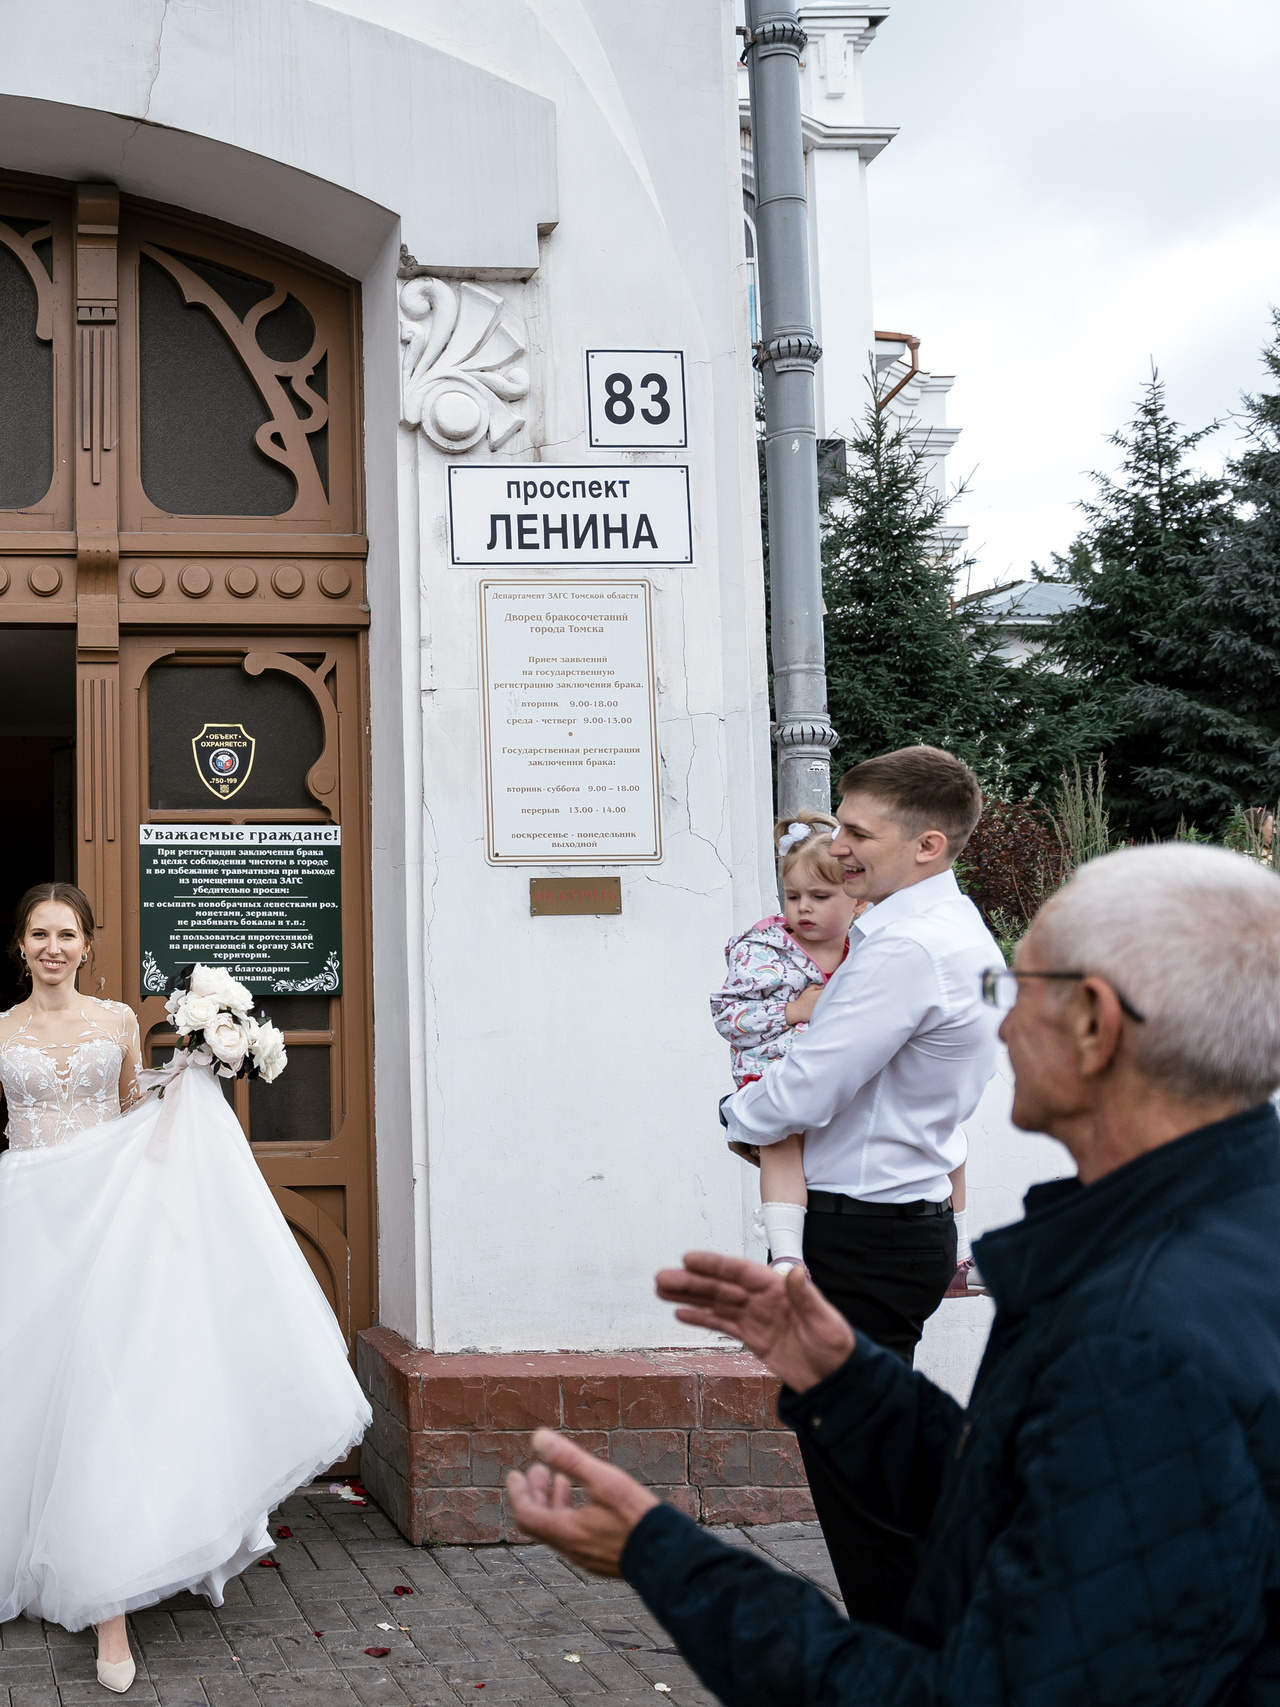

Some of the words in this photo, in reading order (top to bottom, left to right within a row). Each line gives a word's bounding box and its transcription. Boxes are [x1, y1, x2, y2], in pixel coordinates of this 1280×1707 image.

[604, 373, 670, 425] 83
[507, 480, 629, 505] проспект
[487, 514, 658, 550] ЛЕНИНА
[492, 592, 545, 600] Департамент
[504, 613, 542, 622] Дворец
[545, 612, 628, 622] бракосочетаний
[530, 626, 565, 635] города
[569, 625, 604, 633] Томска
[528, 656, 557, 665] Прием
[494, 682, 554, 690] регистрацию
[614, 681, 644, 689] брака.
[583, 747, 640, 755] регистрация
[586, 759, 616, 767] брака:
[521, 807, 560, 815] перерыв
[143, 829, 244, 841] Уважаемые
[250, 829, 338, 843] граждане!
[551, 841, 597, 849] выходной
[157, 848, 175, 857] При
[179, 849, 236, 857] регистрации
[297, 848, 324, 856] брака
[190, 858, 246, 866] соблюдения
[297, 859, 328, 867] городе
[221, 868, 280, 876] травматизма
[193, 887, 251, 895] убедительно
[536, 890, 555, 901] НЕ
[560, 890, 617, 901] КУРИТЬ
[195, 910, 244, 918] монетами,
[246, 910, 287, 918] зернами,
[257, 943, 288, 951] органу
[290, 942, 314, 950] ЗАГС
[235, 965, 290, 973] благодарим
